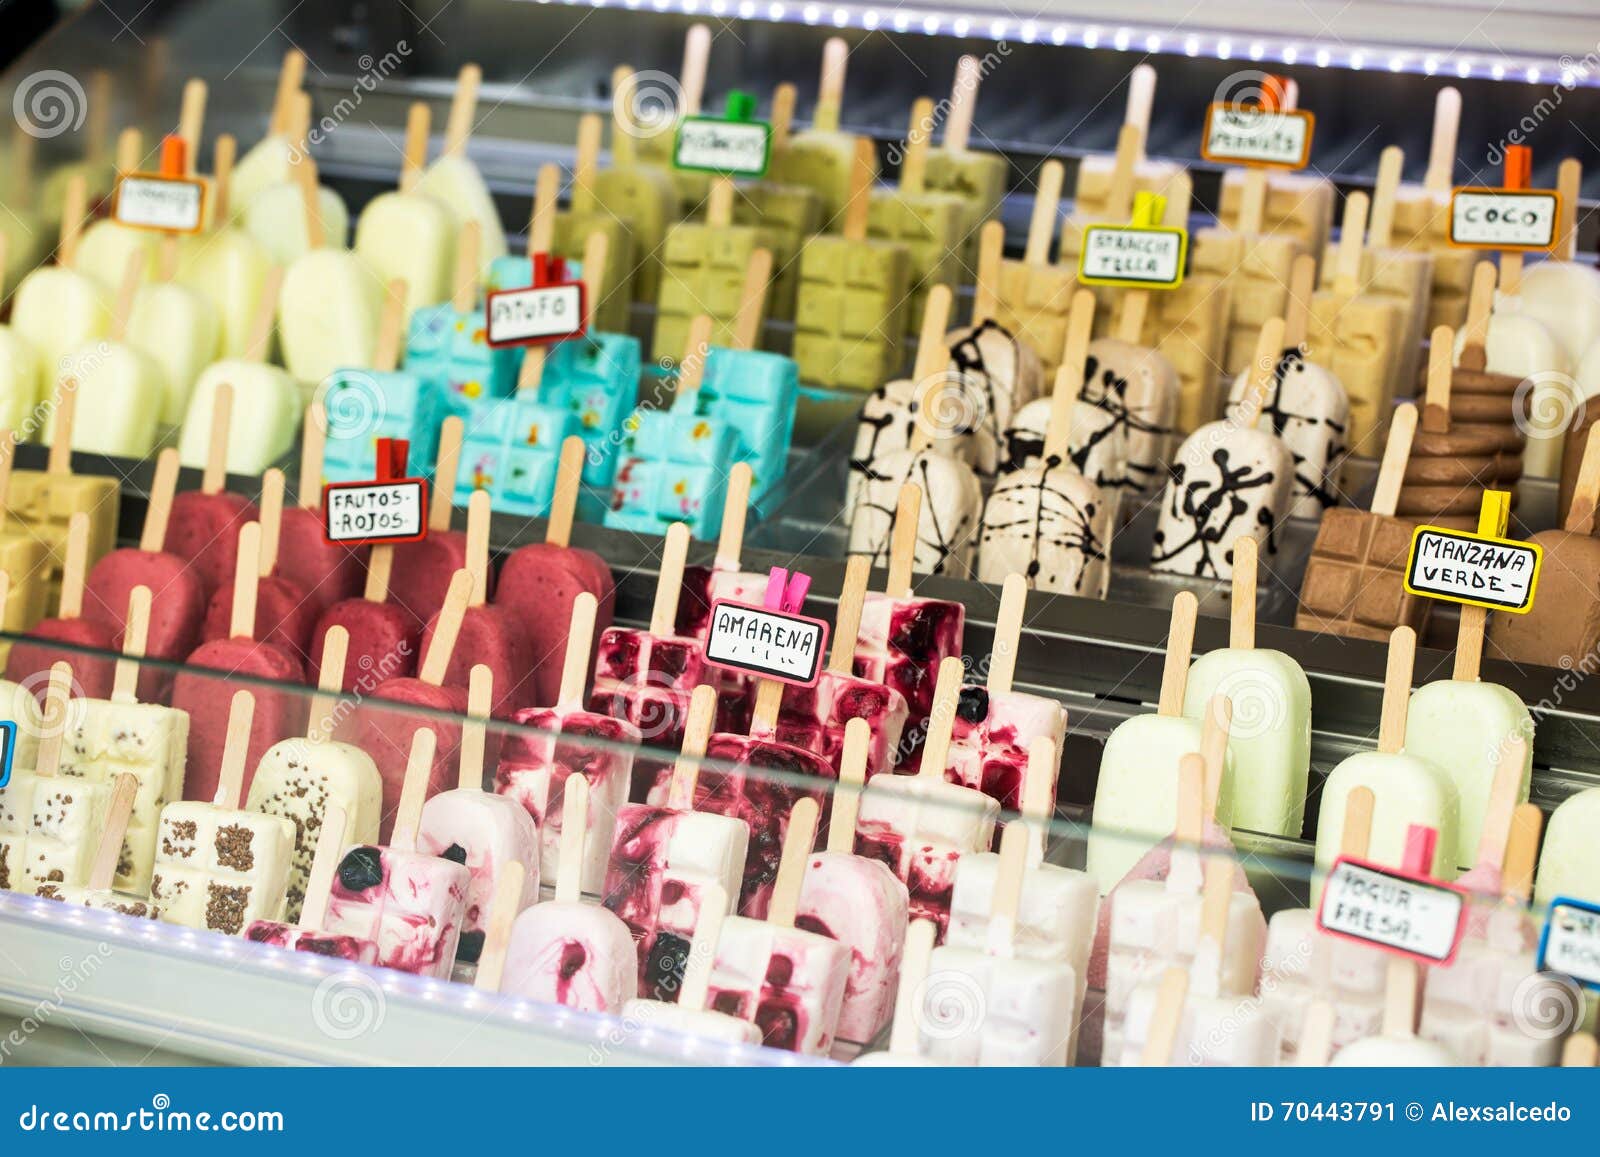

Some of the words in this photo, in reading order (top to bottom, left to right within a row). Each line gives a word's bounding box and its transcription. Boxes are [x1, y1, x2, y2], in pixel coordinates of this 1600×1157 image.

[1465, 206, 1538, 227] COCO
[1423, 537, 1527, 571] MANZANA
[718, 612, 814, 656] AMARENA
